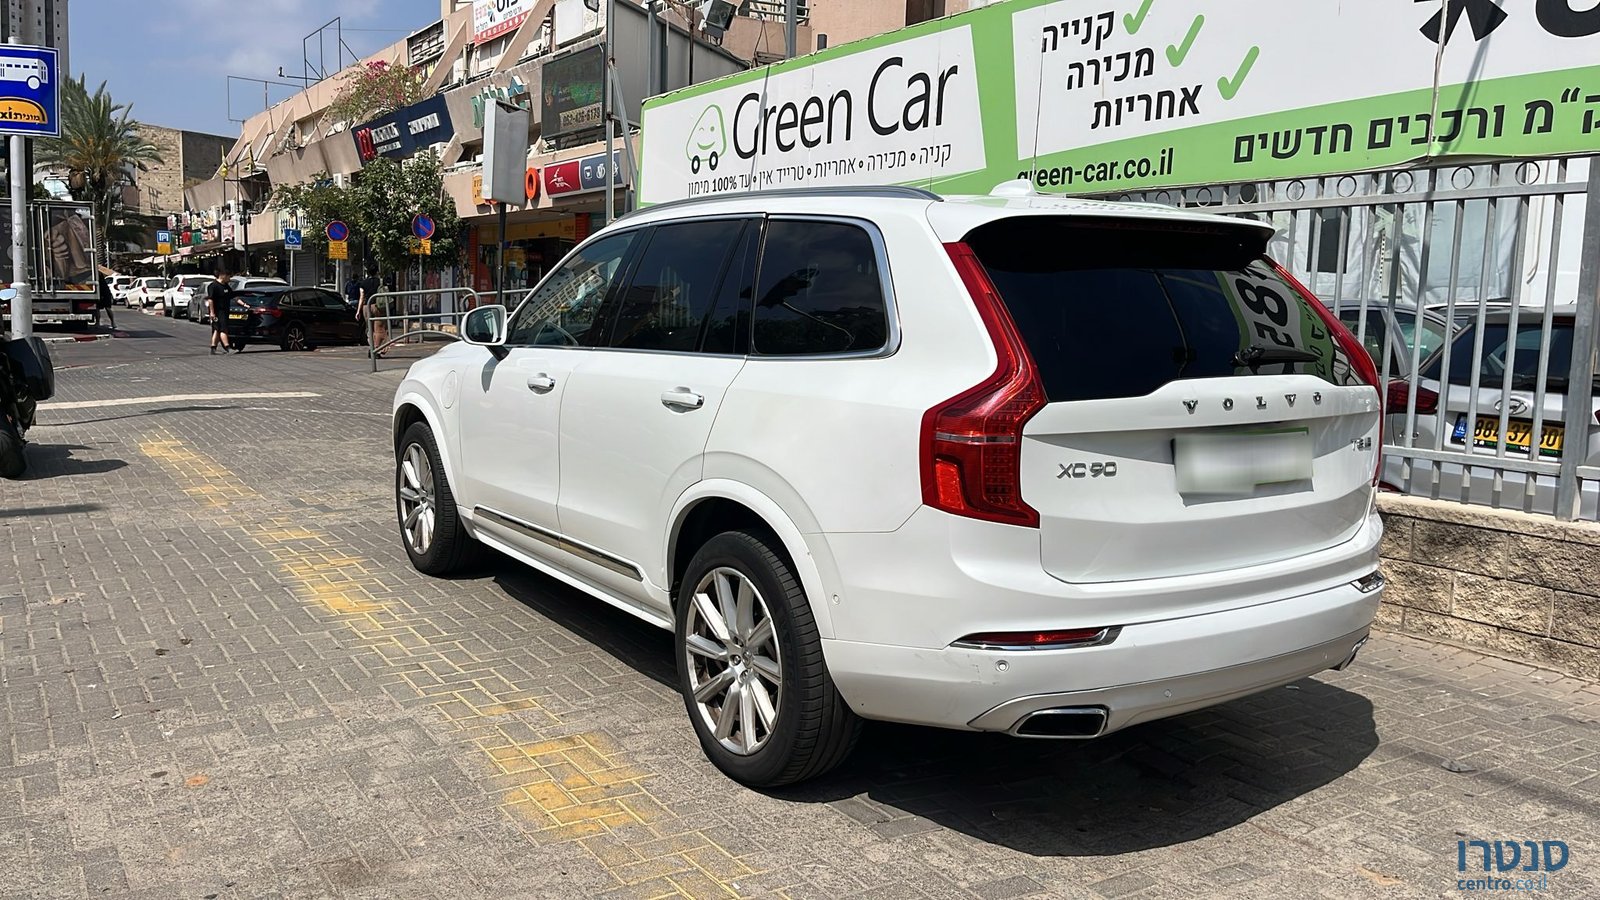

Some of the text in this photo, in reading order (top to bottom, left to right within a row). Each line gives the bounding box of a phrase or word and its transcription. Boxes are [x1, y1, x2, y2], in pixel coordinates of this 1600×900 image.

[1041, 11, 1114, 53] קנייה
[1067, 48, 1154, 90] מכירה
[732, 56, 958, 160] Green Car
[1091, 85, 1203, 129] אחריות
[1367, 105, 1505, 150] ורכבים
[1234, 123, 1352, 163] חדשים
[688, 143, 951, 198] קניה מכירה אחריות טרייד אין עד 100% מימון
[1183, 391, 1322, 414] VOLVO
